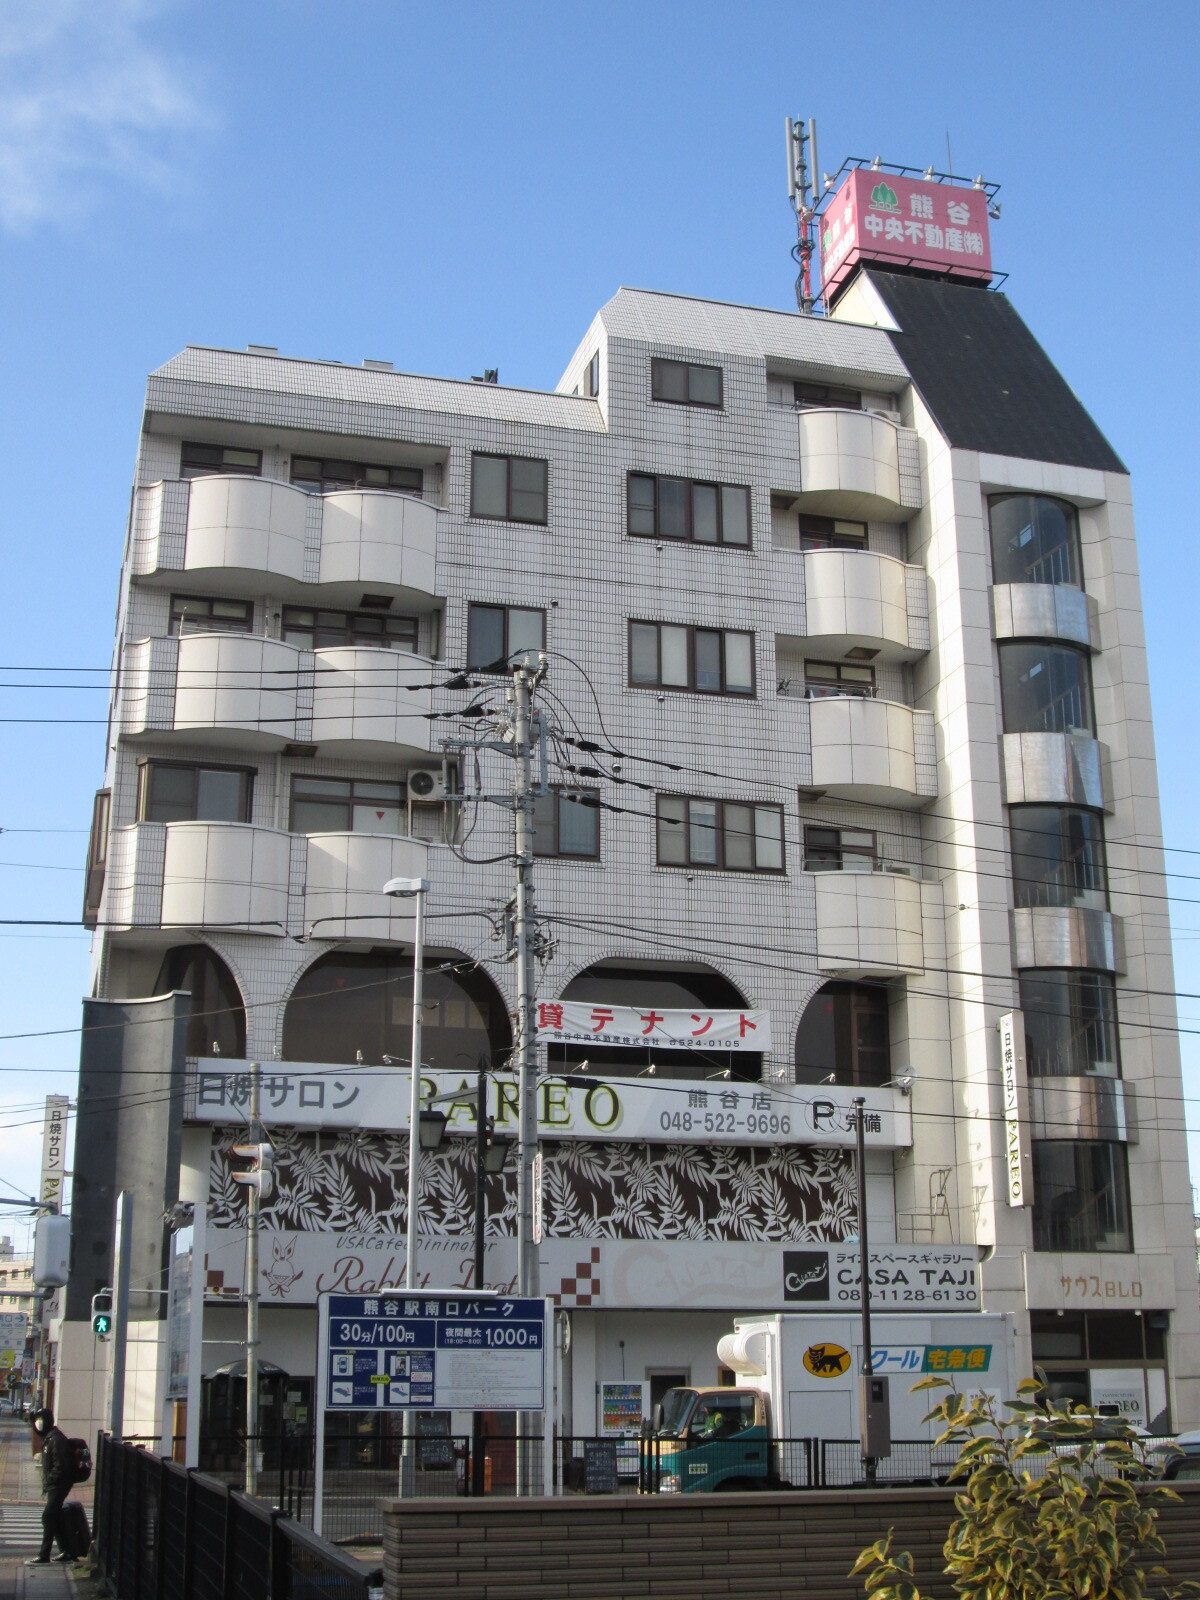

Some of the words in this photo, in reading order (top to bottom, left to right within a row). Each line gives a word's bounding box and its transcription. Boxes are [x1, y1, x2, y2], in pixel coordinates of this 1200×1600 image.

[909, 193, 970, 226] 熊谷
[537, 1003, 757, 1037] 貸テナント
[1004, 1032, 1015, 1107] 日焼サロン
[198, 1073, 360, 1109] 日焼サロン
[687, 1089, 772, 1111] 熊谷店
[660, 1111, 791, 1134] 048-522-9696
[49, 1110, 61, 1169] 日焼サロン
[837, 1252, 974, 1264] ライスペースギャラリー
[919, 1269, 975, 1285] TAJI
[363, 1299, 515, 1316] 熊谷駅南口パーク
[340, 1323, 415, 1343] 30分/100円
[445, 1327, 482, 1337] 夜間最大
[928, 1348, 986, 1370] 宅急便
